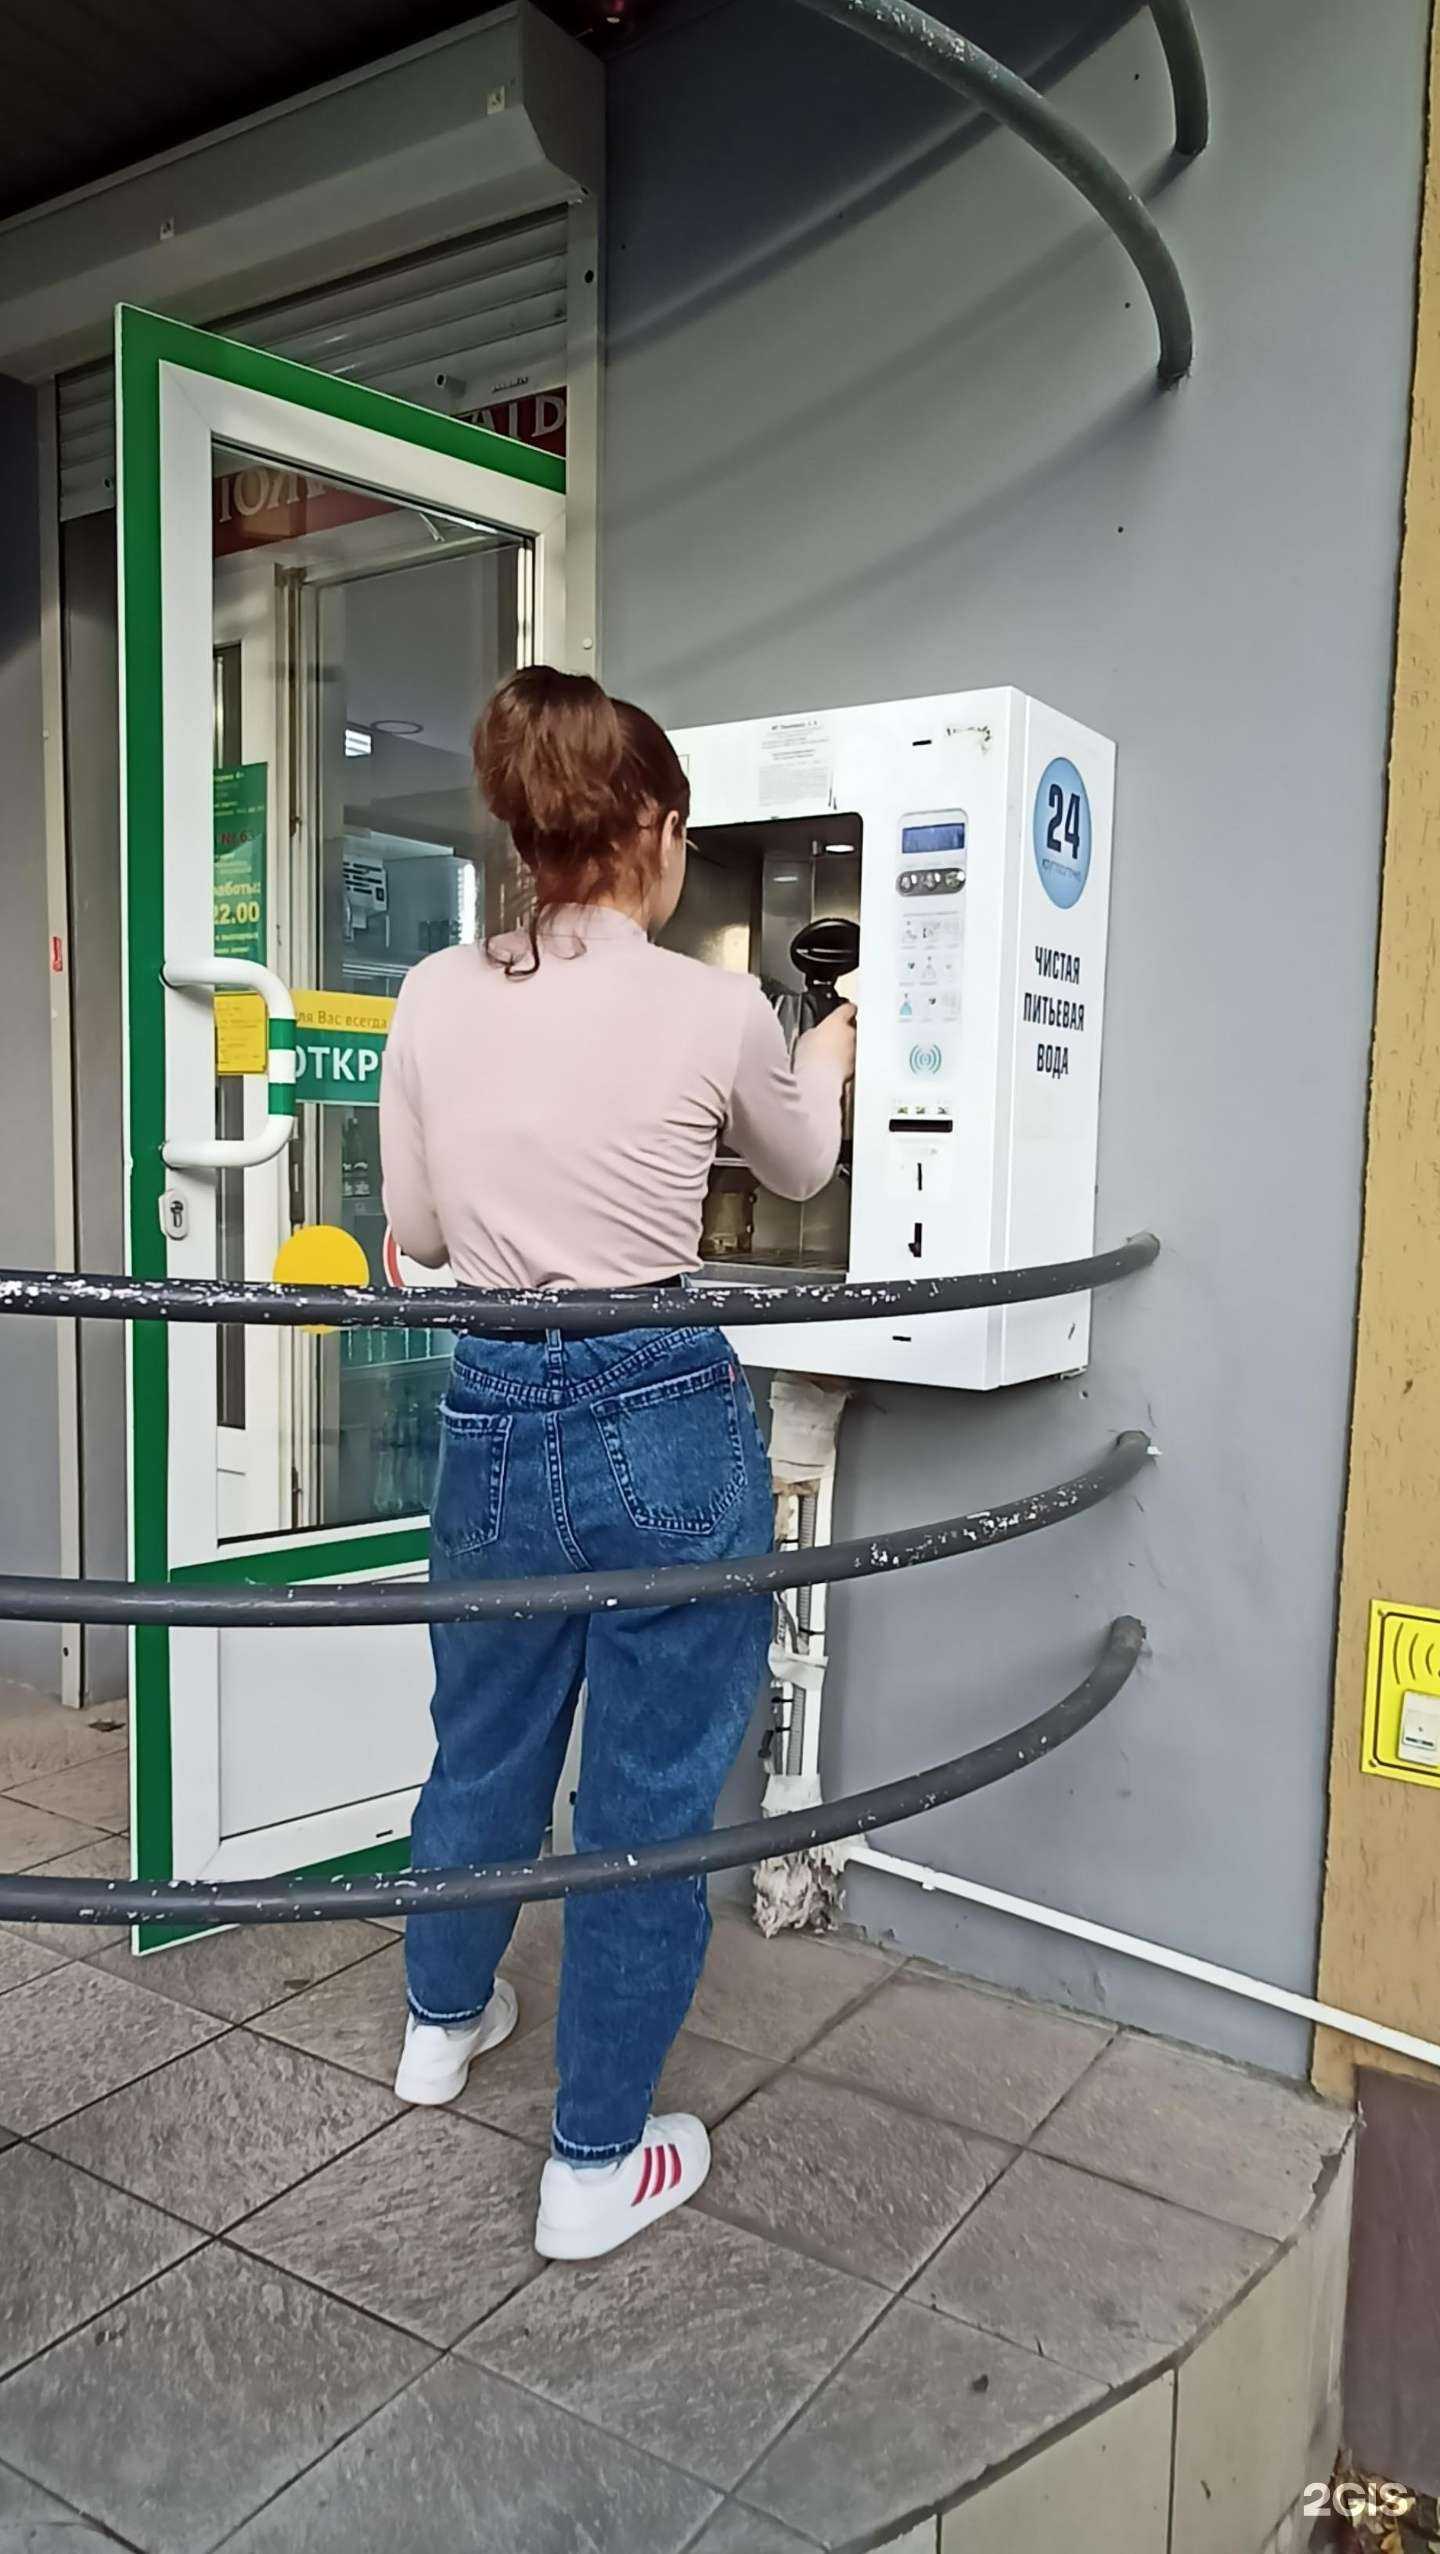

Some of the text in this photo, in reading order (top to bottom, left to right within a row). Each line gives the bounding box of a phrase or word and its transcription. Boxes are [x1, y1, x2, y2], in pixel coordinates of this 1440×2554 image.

[1046, 784, 1080, 860] 24
[1034, 945, 1080, 985] ЧИСТАЯ
[317, 1010, 341, 1027] Вас
[1023, 991, 1085, 1032] ПИТЬЕВАЯ
[1036, 1043, 1069, 1080] ВОДА
